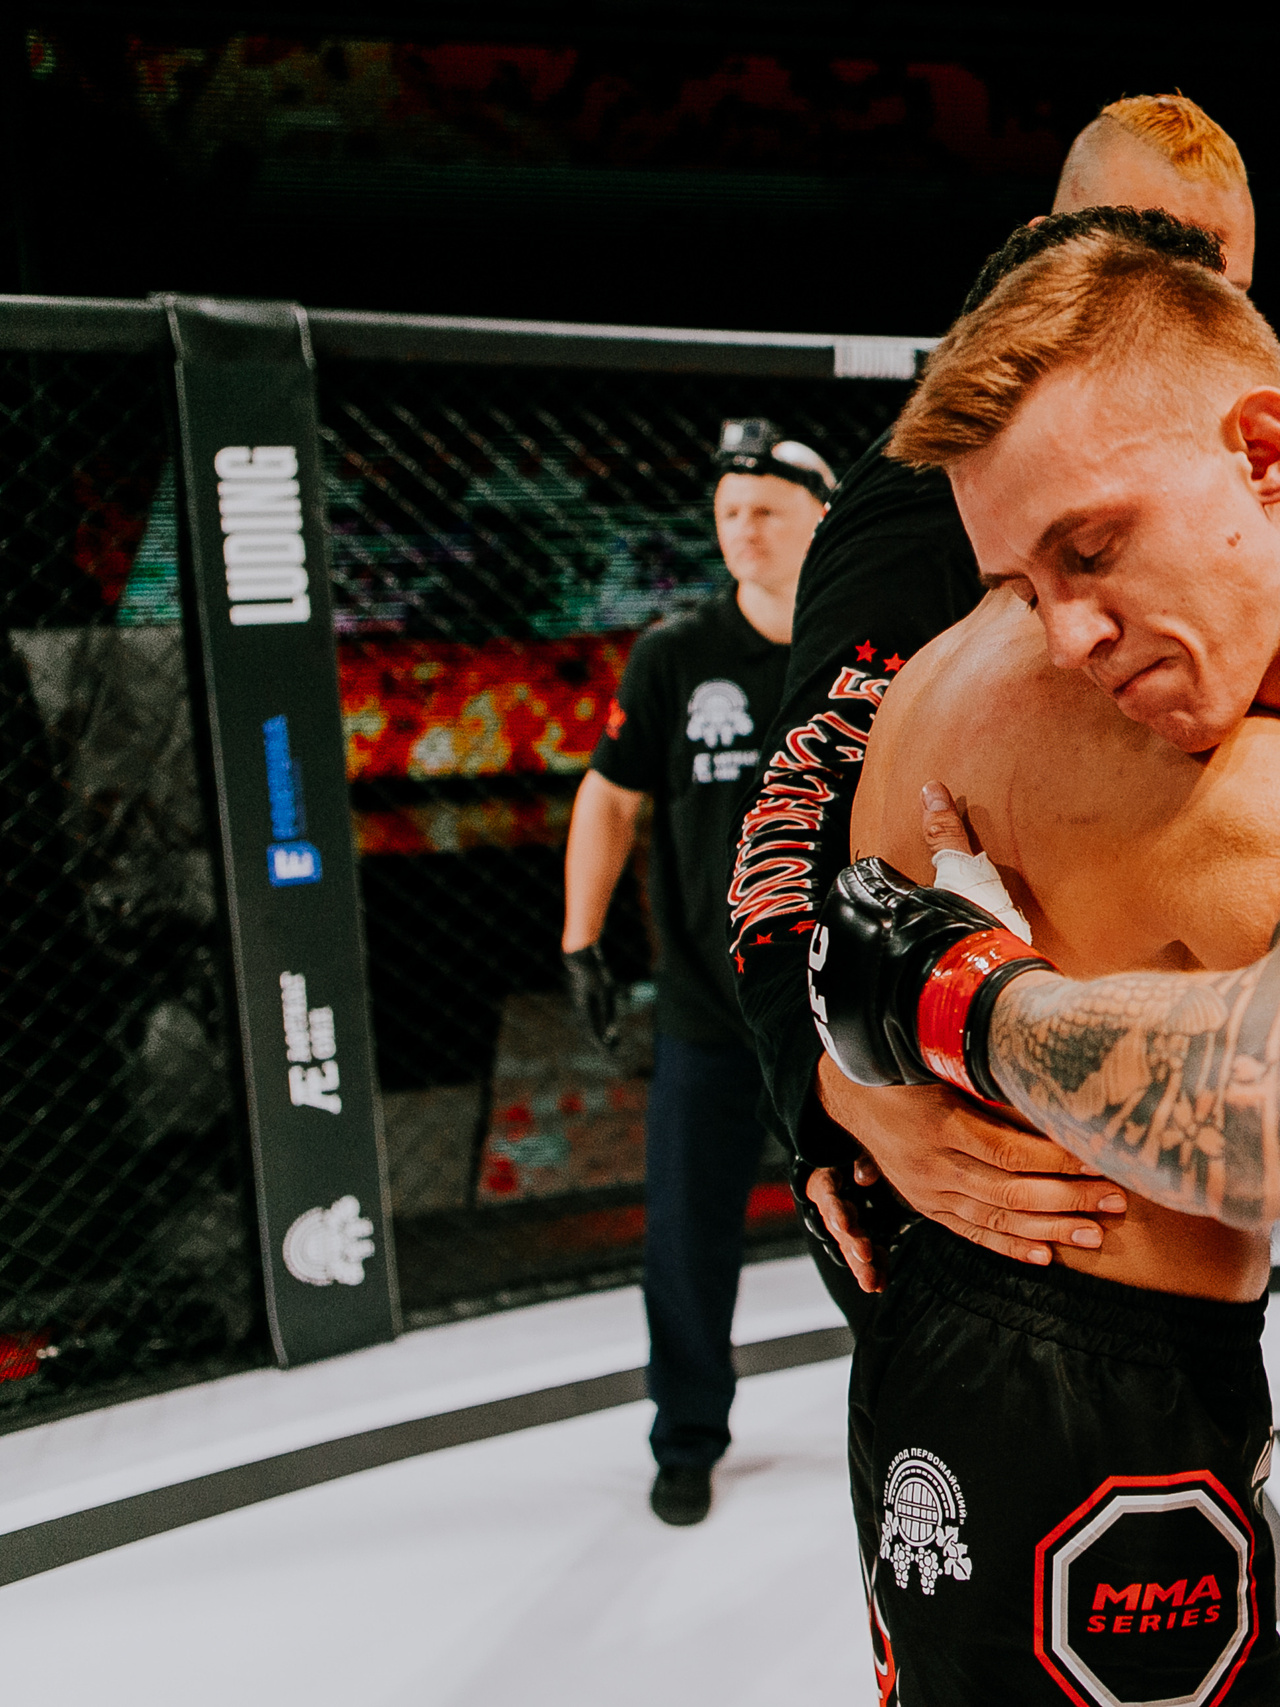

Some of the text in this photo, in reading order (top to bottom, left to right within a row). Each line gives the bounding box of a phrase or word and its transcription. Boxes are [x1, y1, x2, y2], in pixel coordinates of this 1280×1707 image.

[213, 445, 311, 626] LUDING
[1092, 1574, 1222, 1611] MMA
[1086, 1604, 1222, 1634] SERIES
